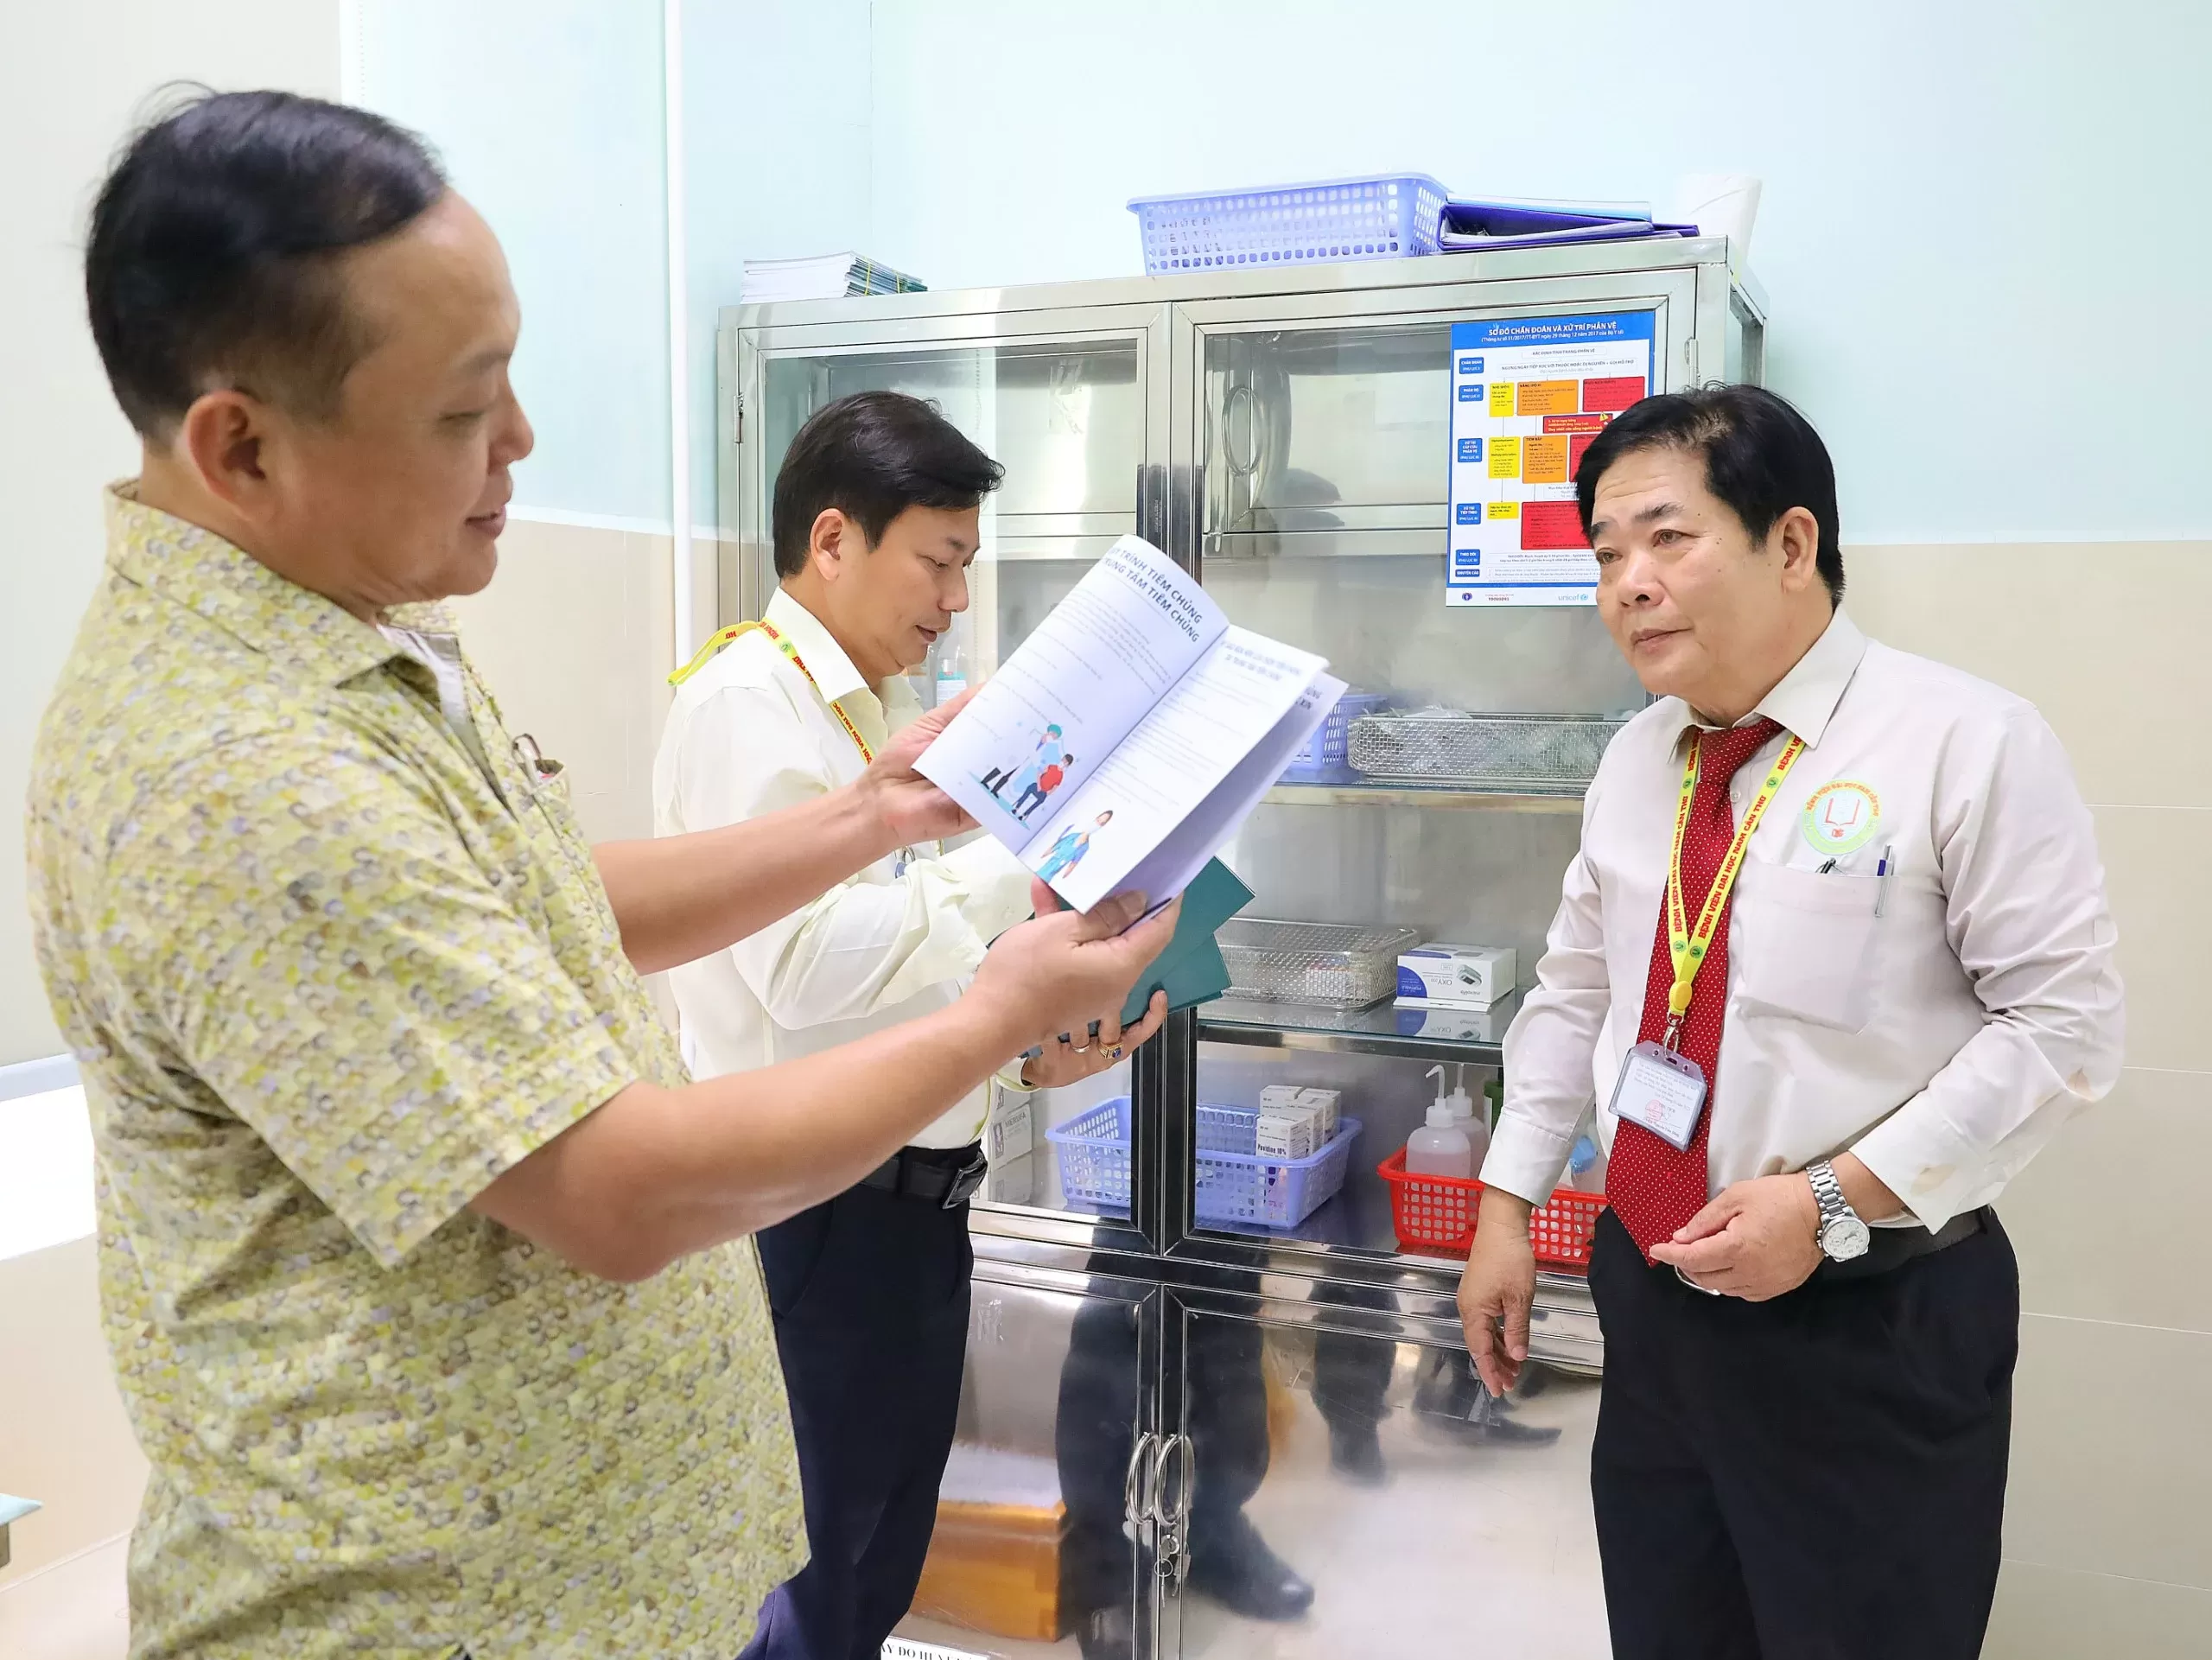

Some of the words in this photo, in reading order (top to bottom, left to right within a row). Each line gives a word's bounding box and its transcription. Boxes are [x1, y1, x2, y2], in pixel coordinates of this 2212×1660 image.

[1126, 569, 1147, 589] TÂM
[1558, 593, 1580, 601] unicef
[1777, 747, 1796, 771] BỆNH
[1698, 913, 1714, 940] BỆNH
[1708, 890, 1722, 913] VIỆN
[1724, 855, 1737, 873] HỌC
[1733, 832, 1747, 855] NAM
[1744, 813, 1758, 831] CẦN
[1753, 794, 1767, 812] THƠ
[1672, 908, 1683, 932] BỆNH
[1276, 1147, 1287, 1155] 10%
